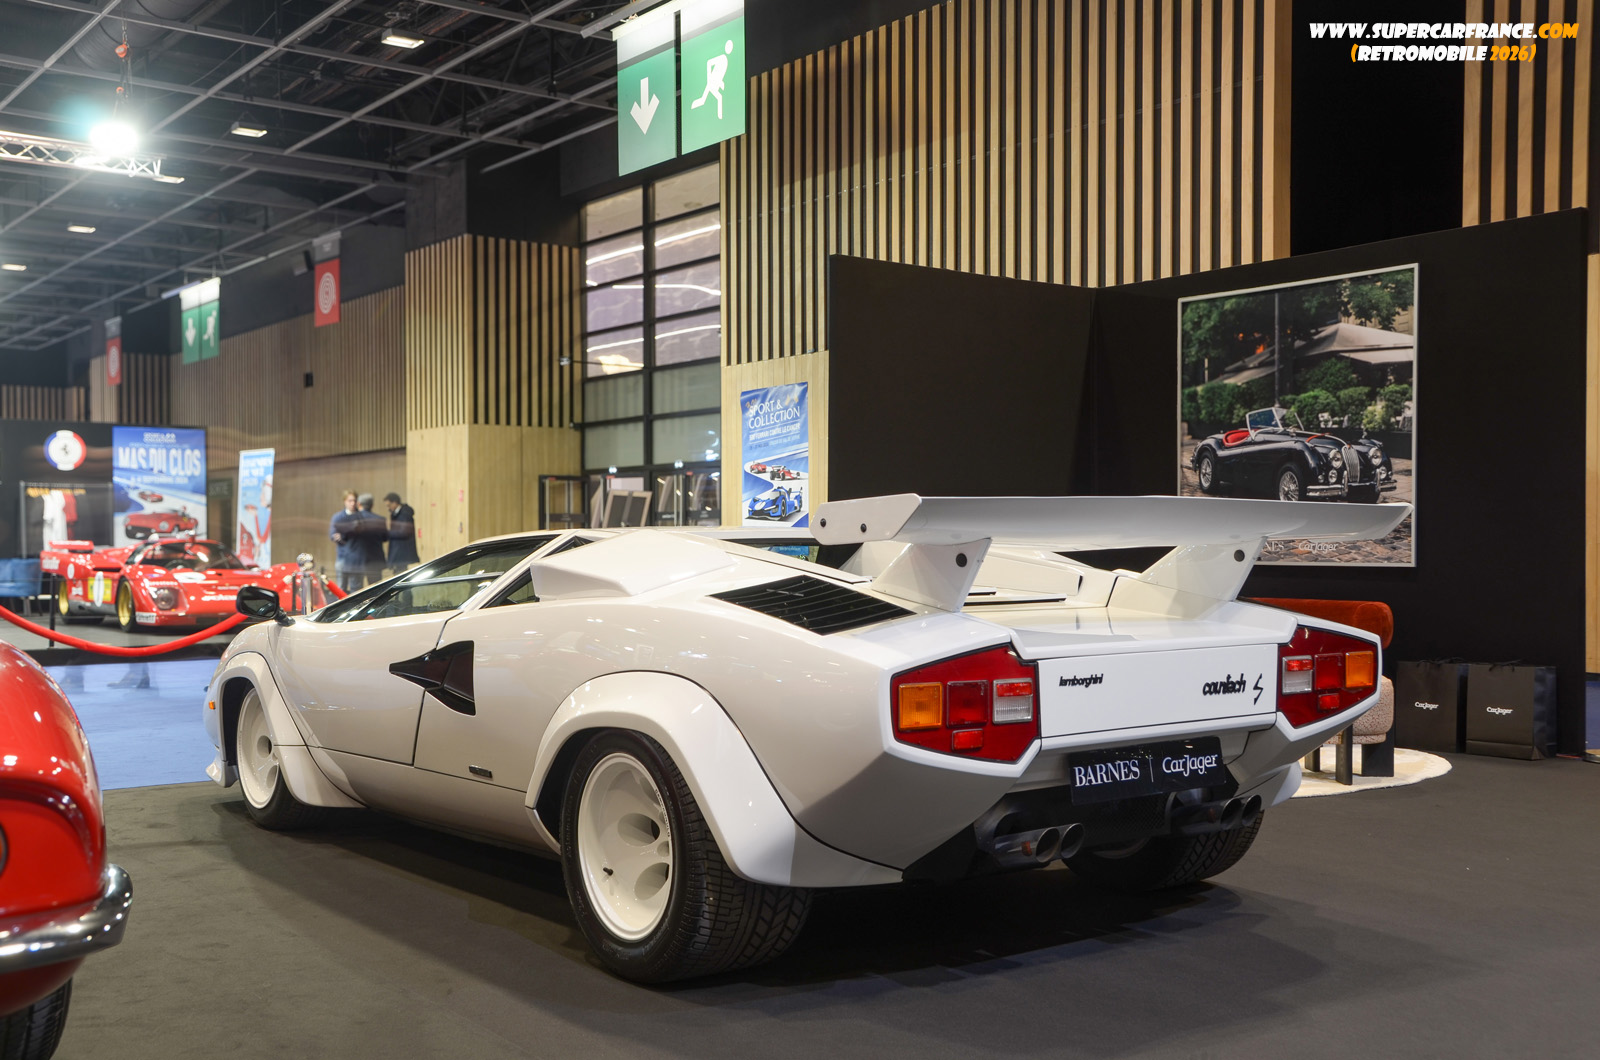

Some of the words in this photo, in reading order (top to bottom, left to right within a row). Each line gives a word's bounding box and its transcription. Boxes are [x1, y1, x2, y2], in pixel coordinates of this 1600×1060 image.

[748, 400, 775, 417] SPORT
[776, 399, 784, 410] &
[748, 405, 800, 429] COLLECTION
[118, 446, 147, 469] MAS
[169, 447, 201, 477] CLOS
[1059, 673, 1104, 688] lamborghini
[1073, 759, 1141, 787] BARNES
[1162, 753, 1218, 777] CarJager
